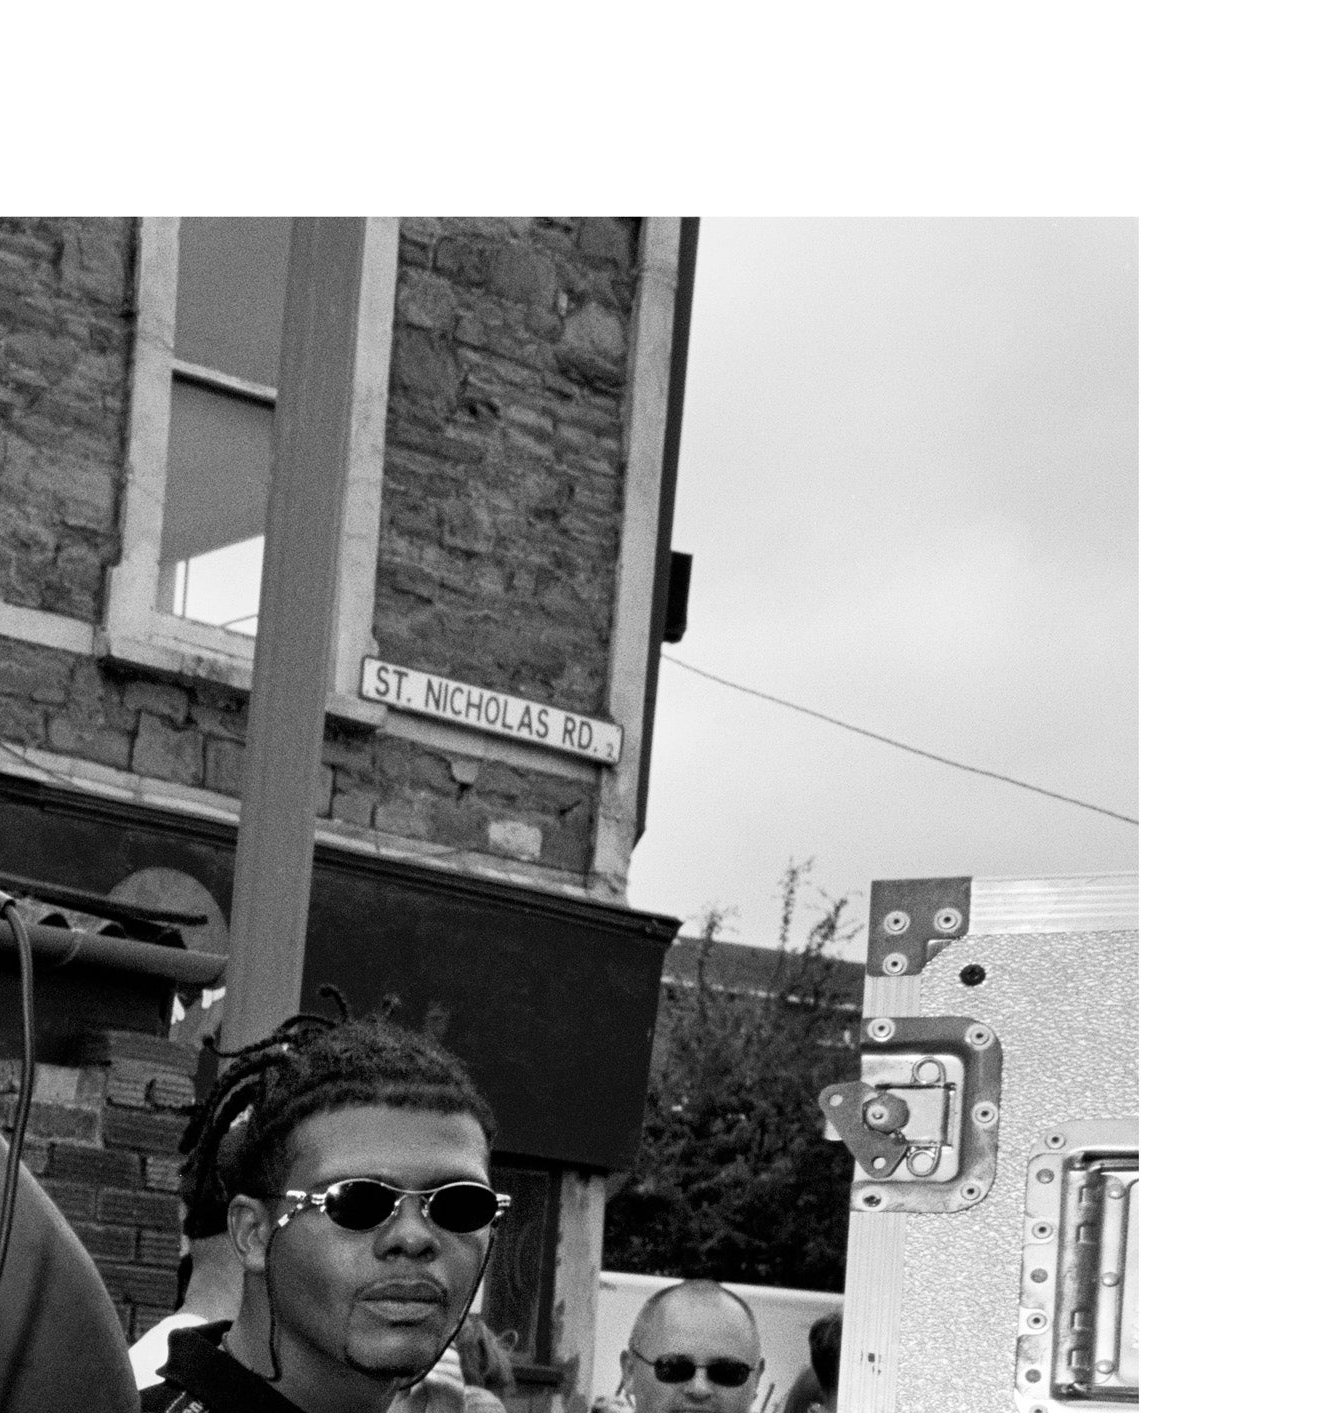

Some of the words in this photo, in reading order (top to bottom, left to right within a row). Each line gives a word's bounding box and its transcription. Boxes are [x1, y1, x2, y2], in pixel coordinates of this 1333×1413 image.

[374, 665, 412, 703] ST.
[424, 678, 550, 739] NICHOLAS
[561, 717, 598, 753] RD.
